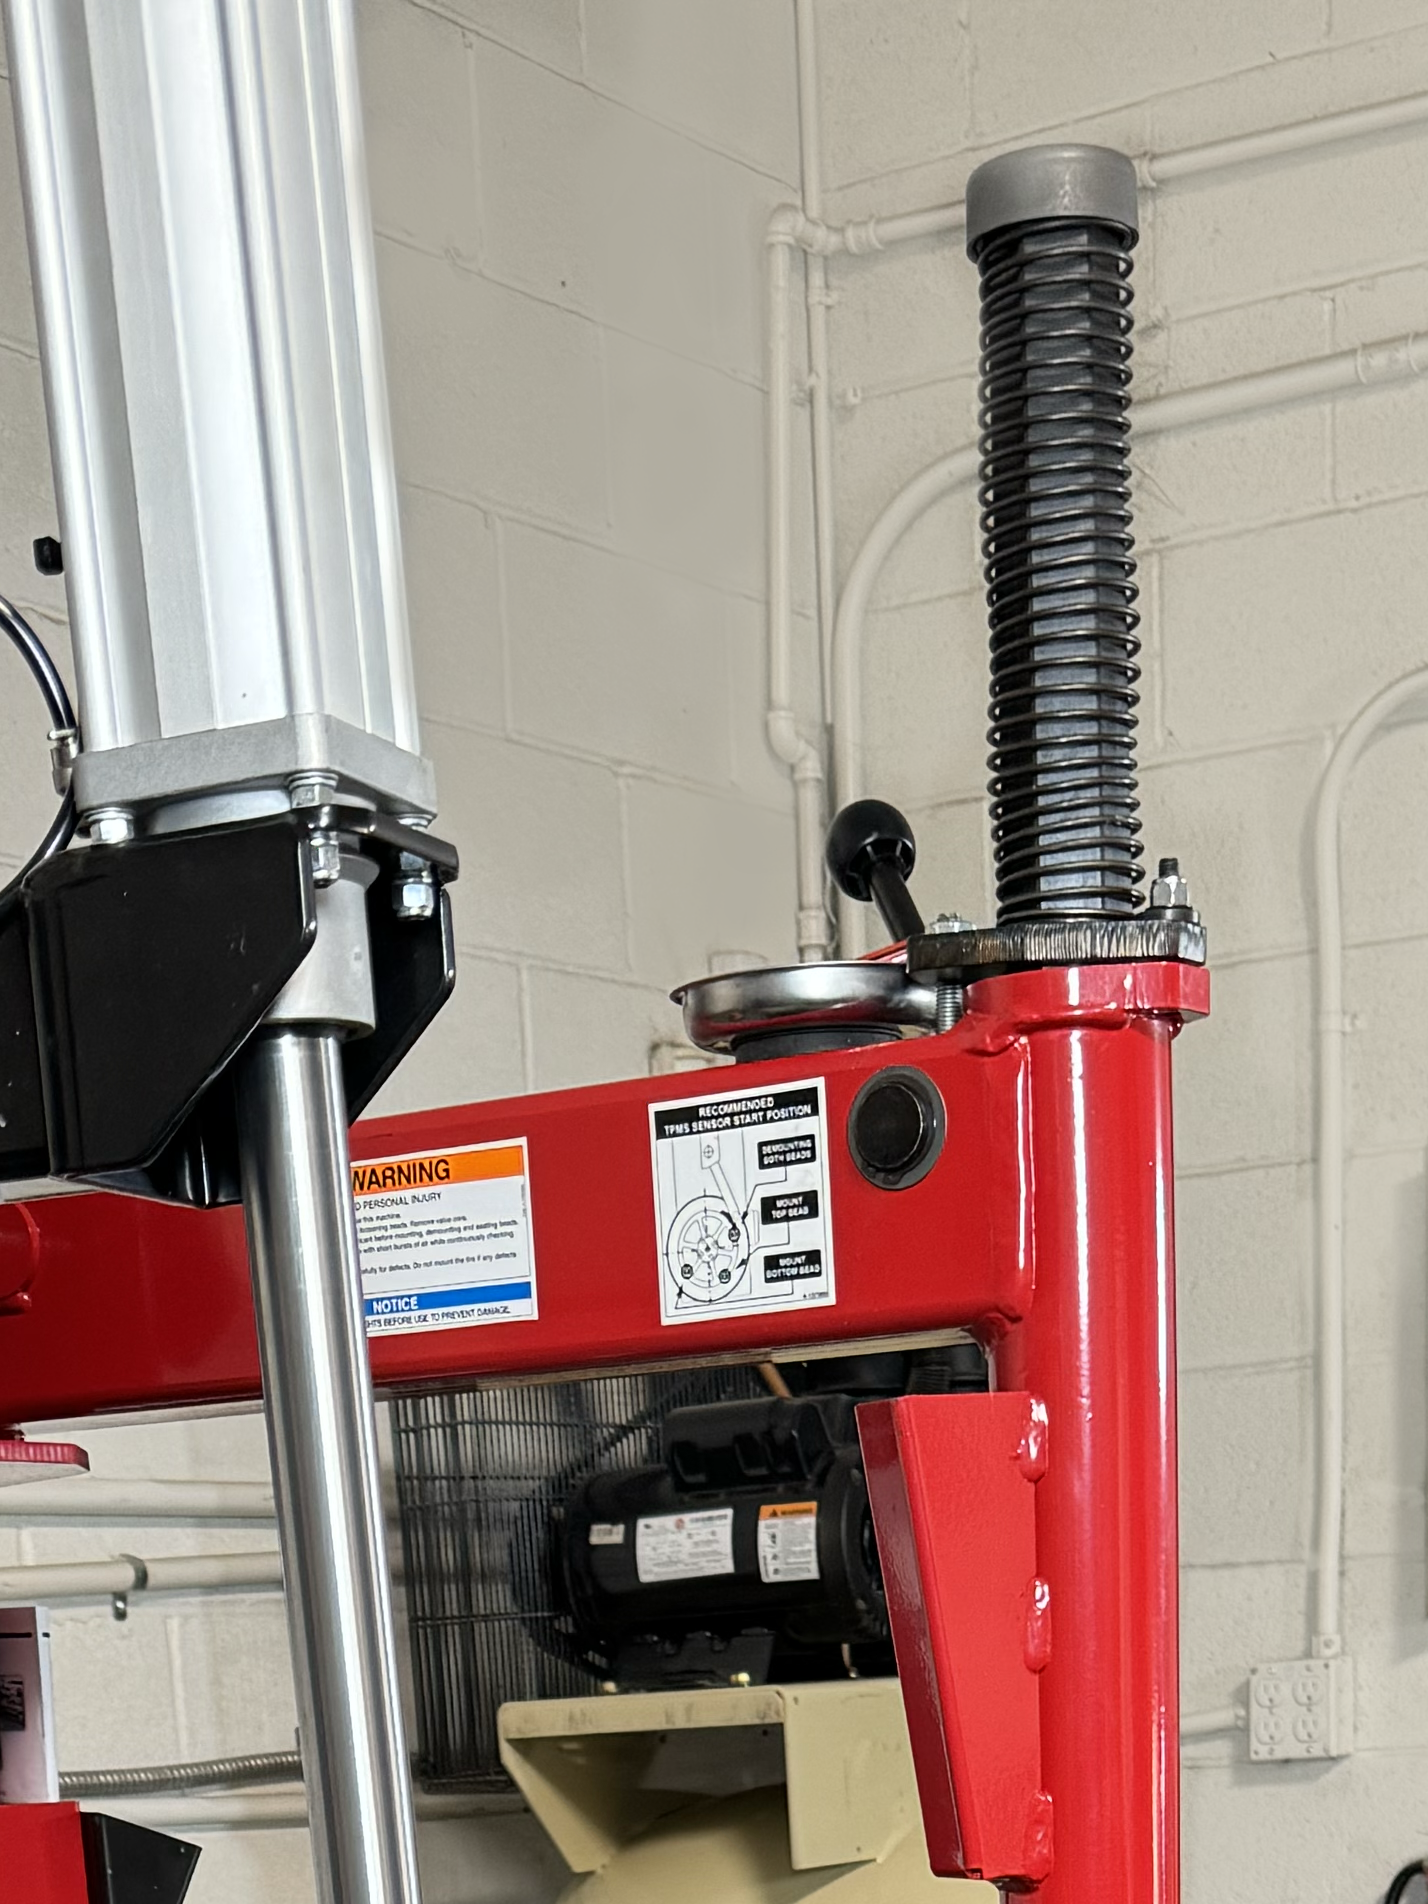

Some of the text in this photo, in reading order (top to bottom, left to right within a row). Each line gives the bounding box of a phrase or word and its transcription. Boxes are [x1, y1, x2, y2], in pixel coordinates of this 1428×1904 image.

[698, 1097, 775, 1117] RECOMMENDED
[664, 1104, 812, 1135] TPMS SENSOR START POSITION
[362, 1195, 410, 1211] PERSONAL
[410, 1191, 443, 1206] INJURY
[373, 1297, 417, 1313] NOTICE
[383, 1315, 413, 1327] BEFORE
[413, 1314, 429, 1324] USE
[430, 1312, 441, 1322] TO
[441, 1309, 475, 1320] PREVENT
